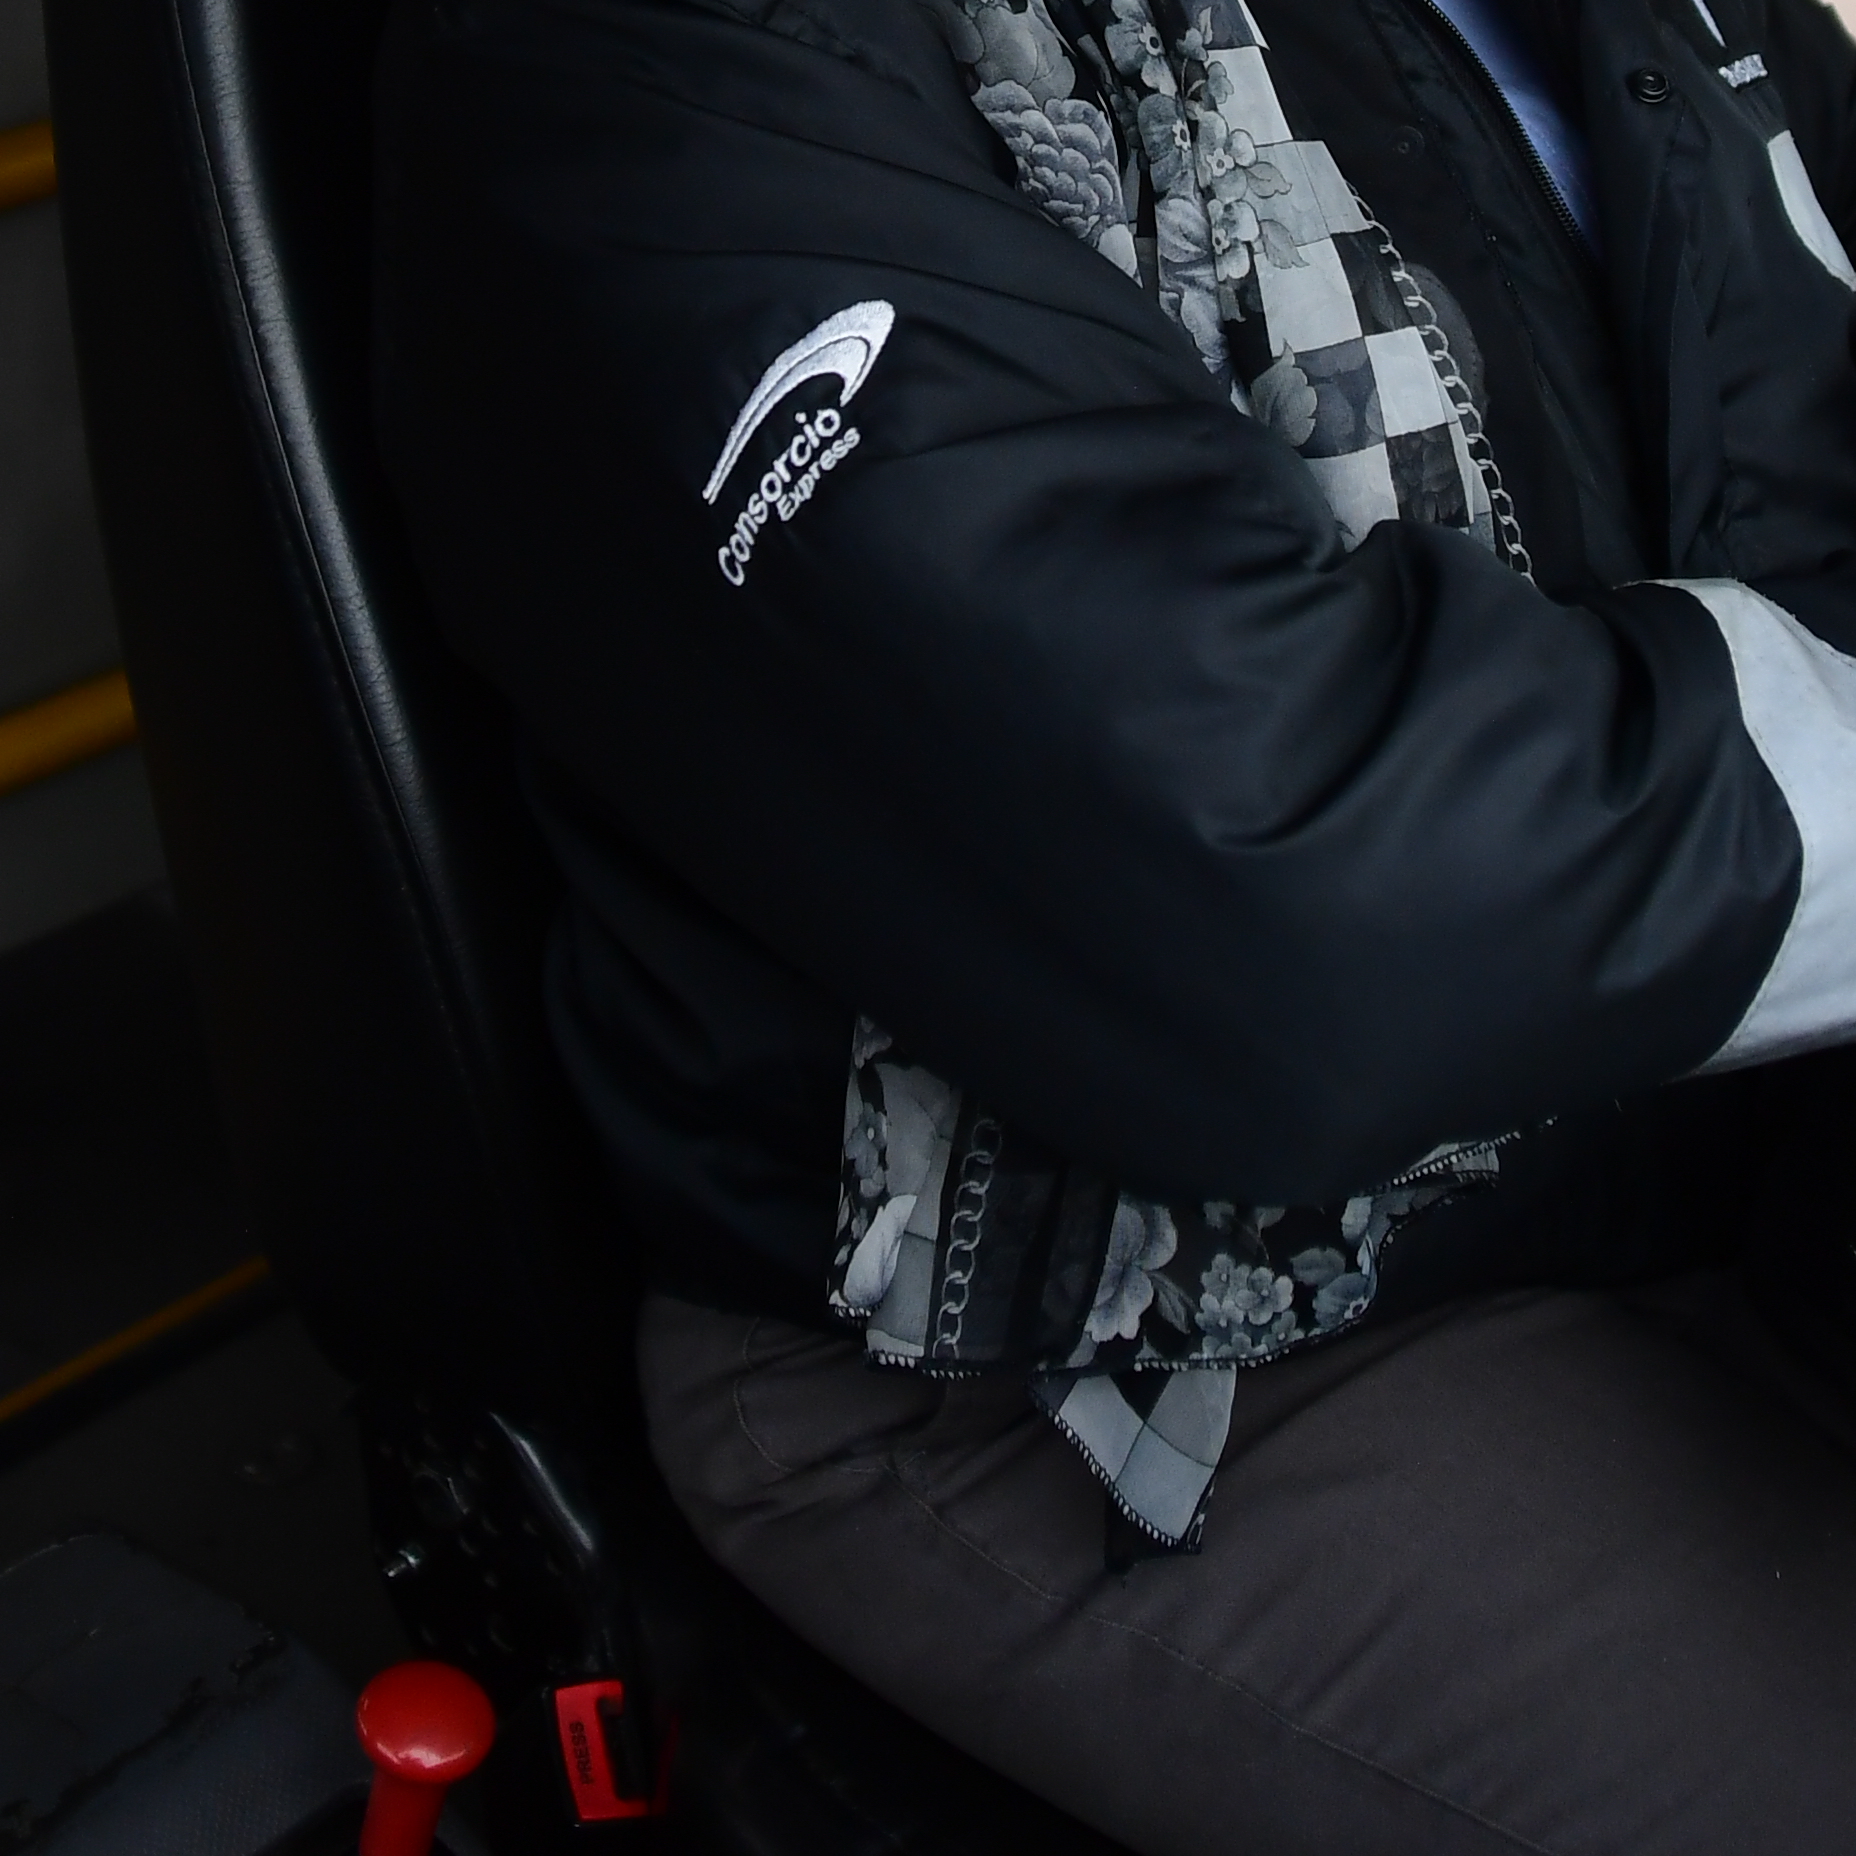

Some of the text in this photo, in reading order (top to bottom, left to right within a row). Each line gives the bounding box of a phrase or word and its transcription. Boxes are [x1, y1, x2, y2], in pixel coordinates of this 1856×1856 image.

[718, 407, 842, 587] Consorcio
[775, 426, 862, 522] Express
[569, 1721, 596, 1785] PRESS
